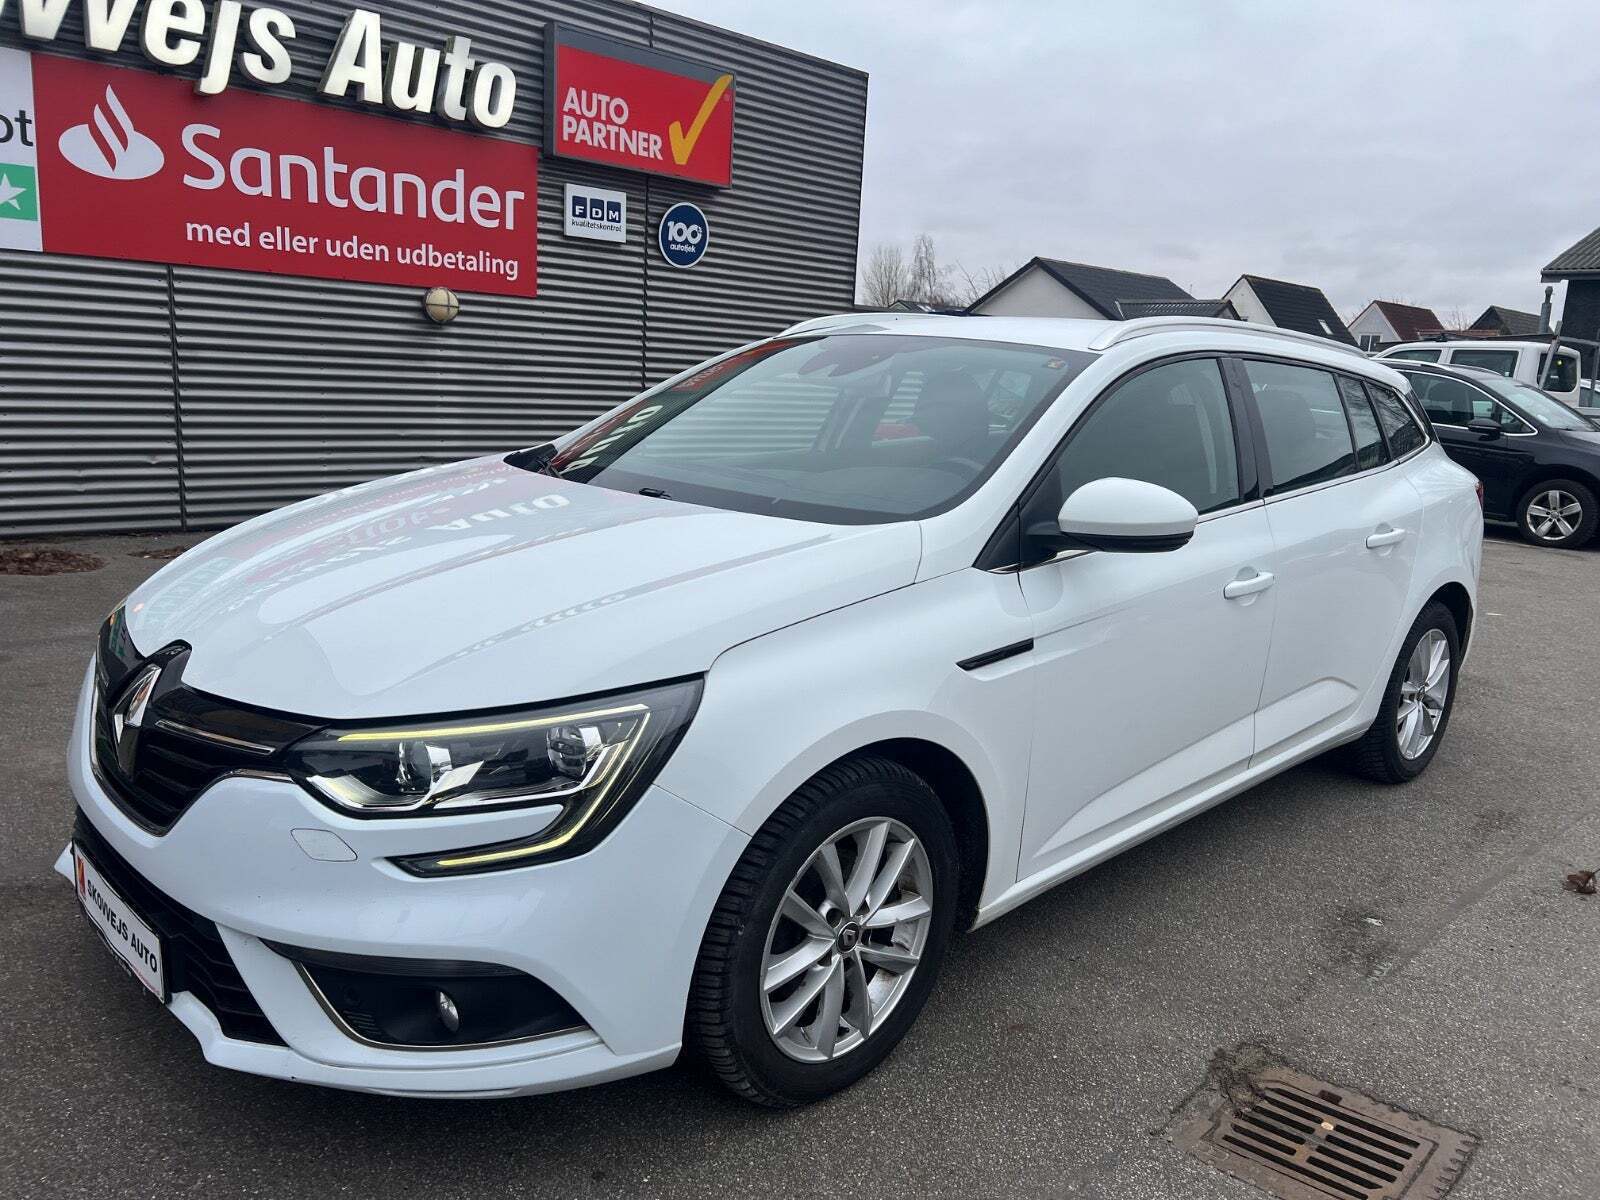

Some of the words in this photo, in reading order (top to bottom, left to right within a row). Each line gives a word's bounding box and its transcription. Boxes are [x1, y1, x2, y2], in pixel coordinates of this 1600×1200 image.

[0, 0, 296, 94] vvejs
[322, 9, 517, 128] Auto
[563, 87, 629, 125] AUTO
[563, 115, 663, 160] PARTNER
[181, 123, 525, 230] Santander
[571, 219, 622, 232] kvalitetskontrol
[575, 205, 619, 221] FDM
[185, 221, 250, 248] med
[258, 226, 318, 254] eller
[327, 237, 389, 262] uden
[397, 245, 519, 281] udbetaling
[131, 932, 157, 973] AUTO
